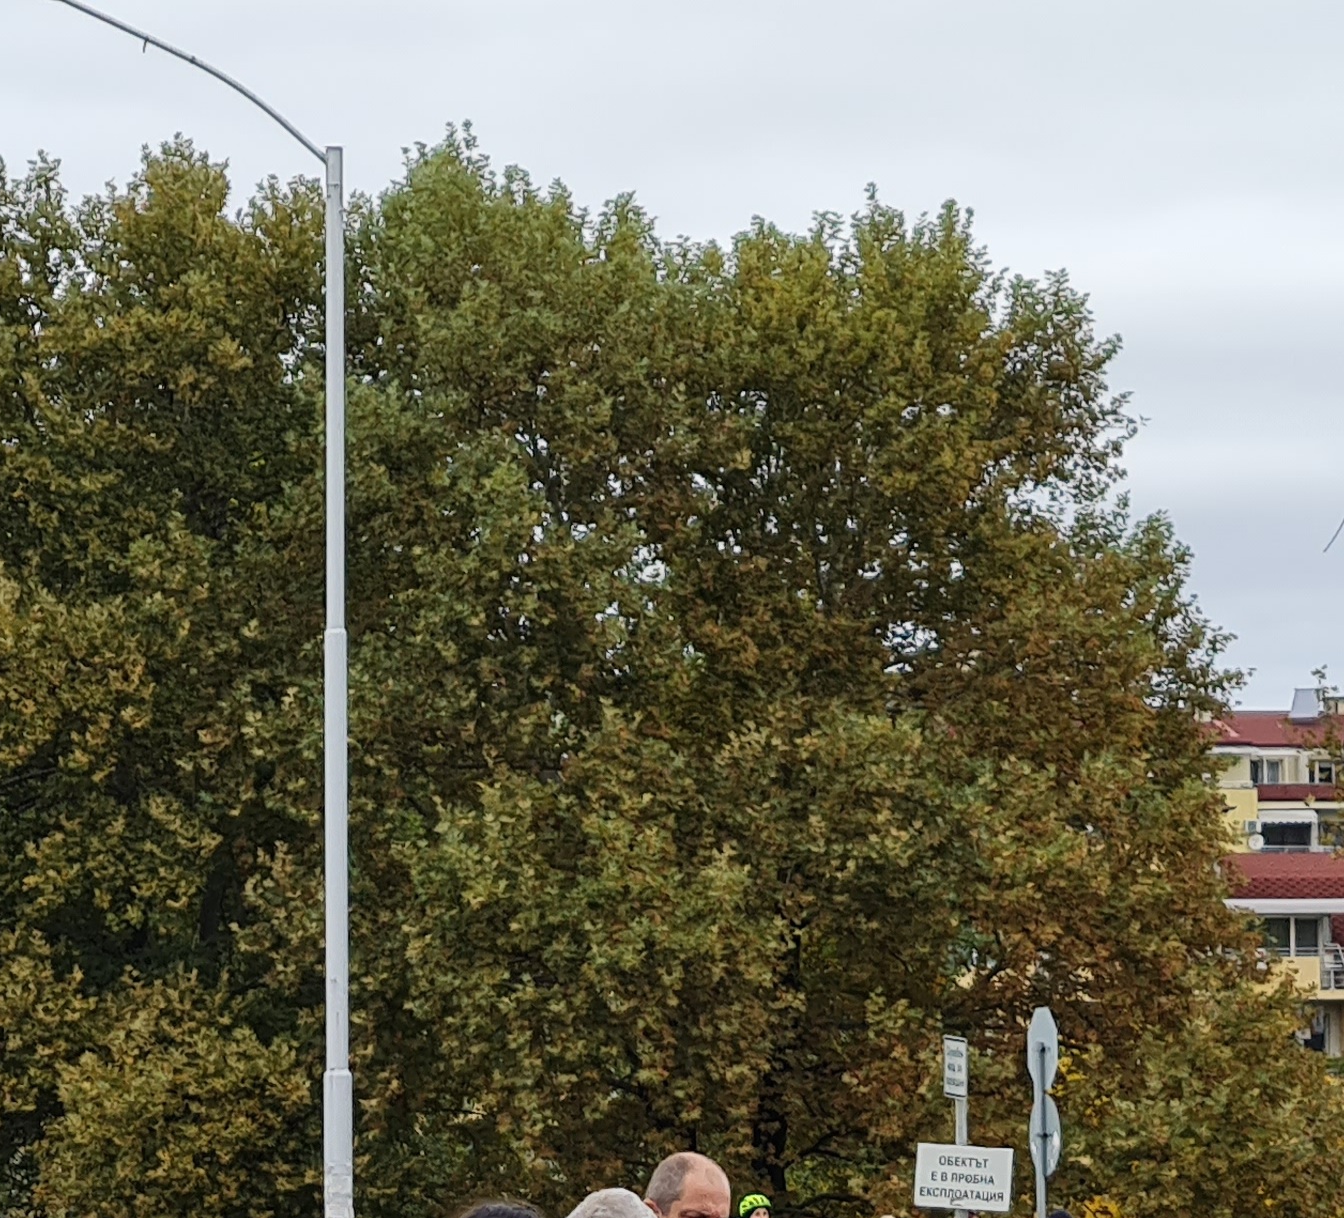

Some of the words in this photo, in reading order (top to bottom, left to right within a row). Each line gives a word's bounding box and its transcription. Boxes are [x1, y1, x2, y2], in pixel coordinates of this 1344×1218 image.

[938, 1155, 989, 1169] ОБЕКТЪТ
[930, 1171, 938, 1181] Е
[940, 1171, 948, 1182] В
[950, 1172, 995, 1185] ПРОБНА
[919, 1186, 1004, 1202] ЕКСПЛОАТАЦИЯ
